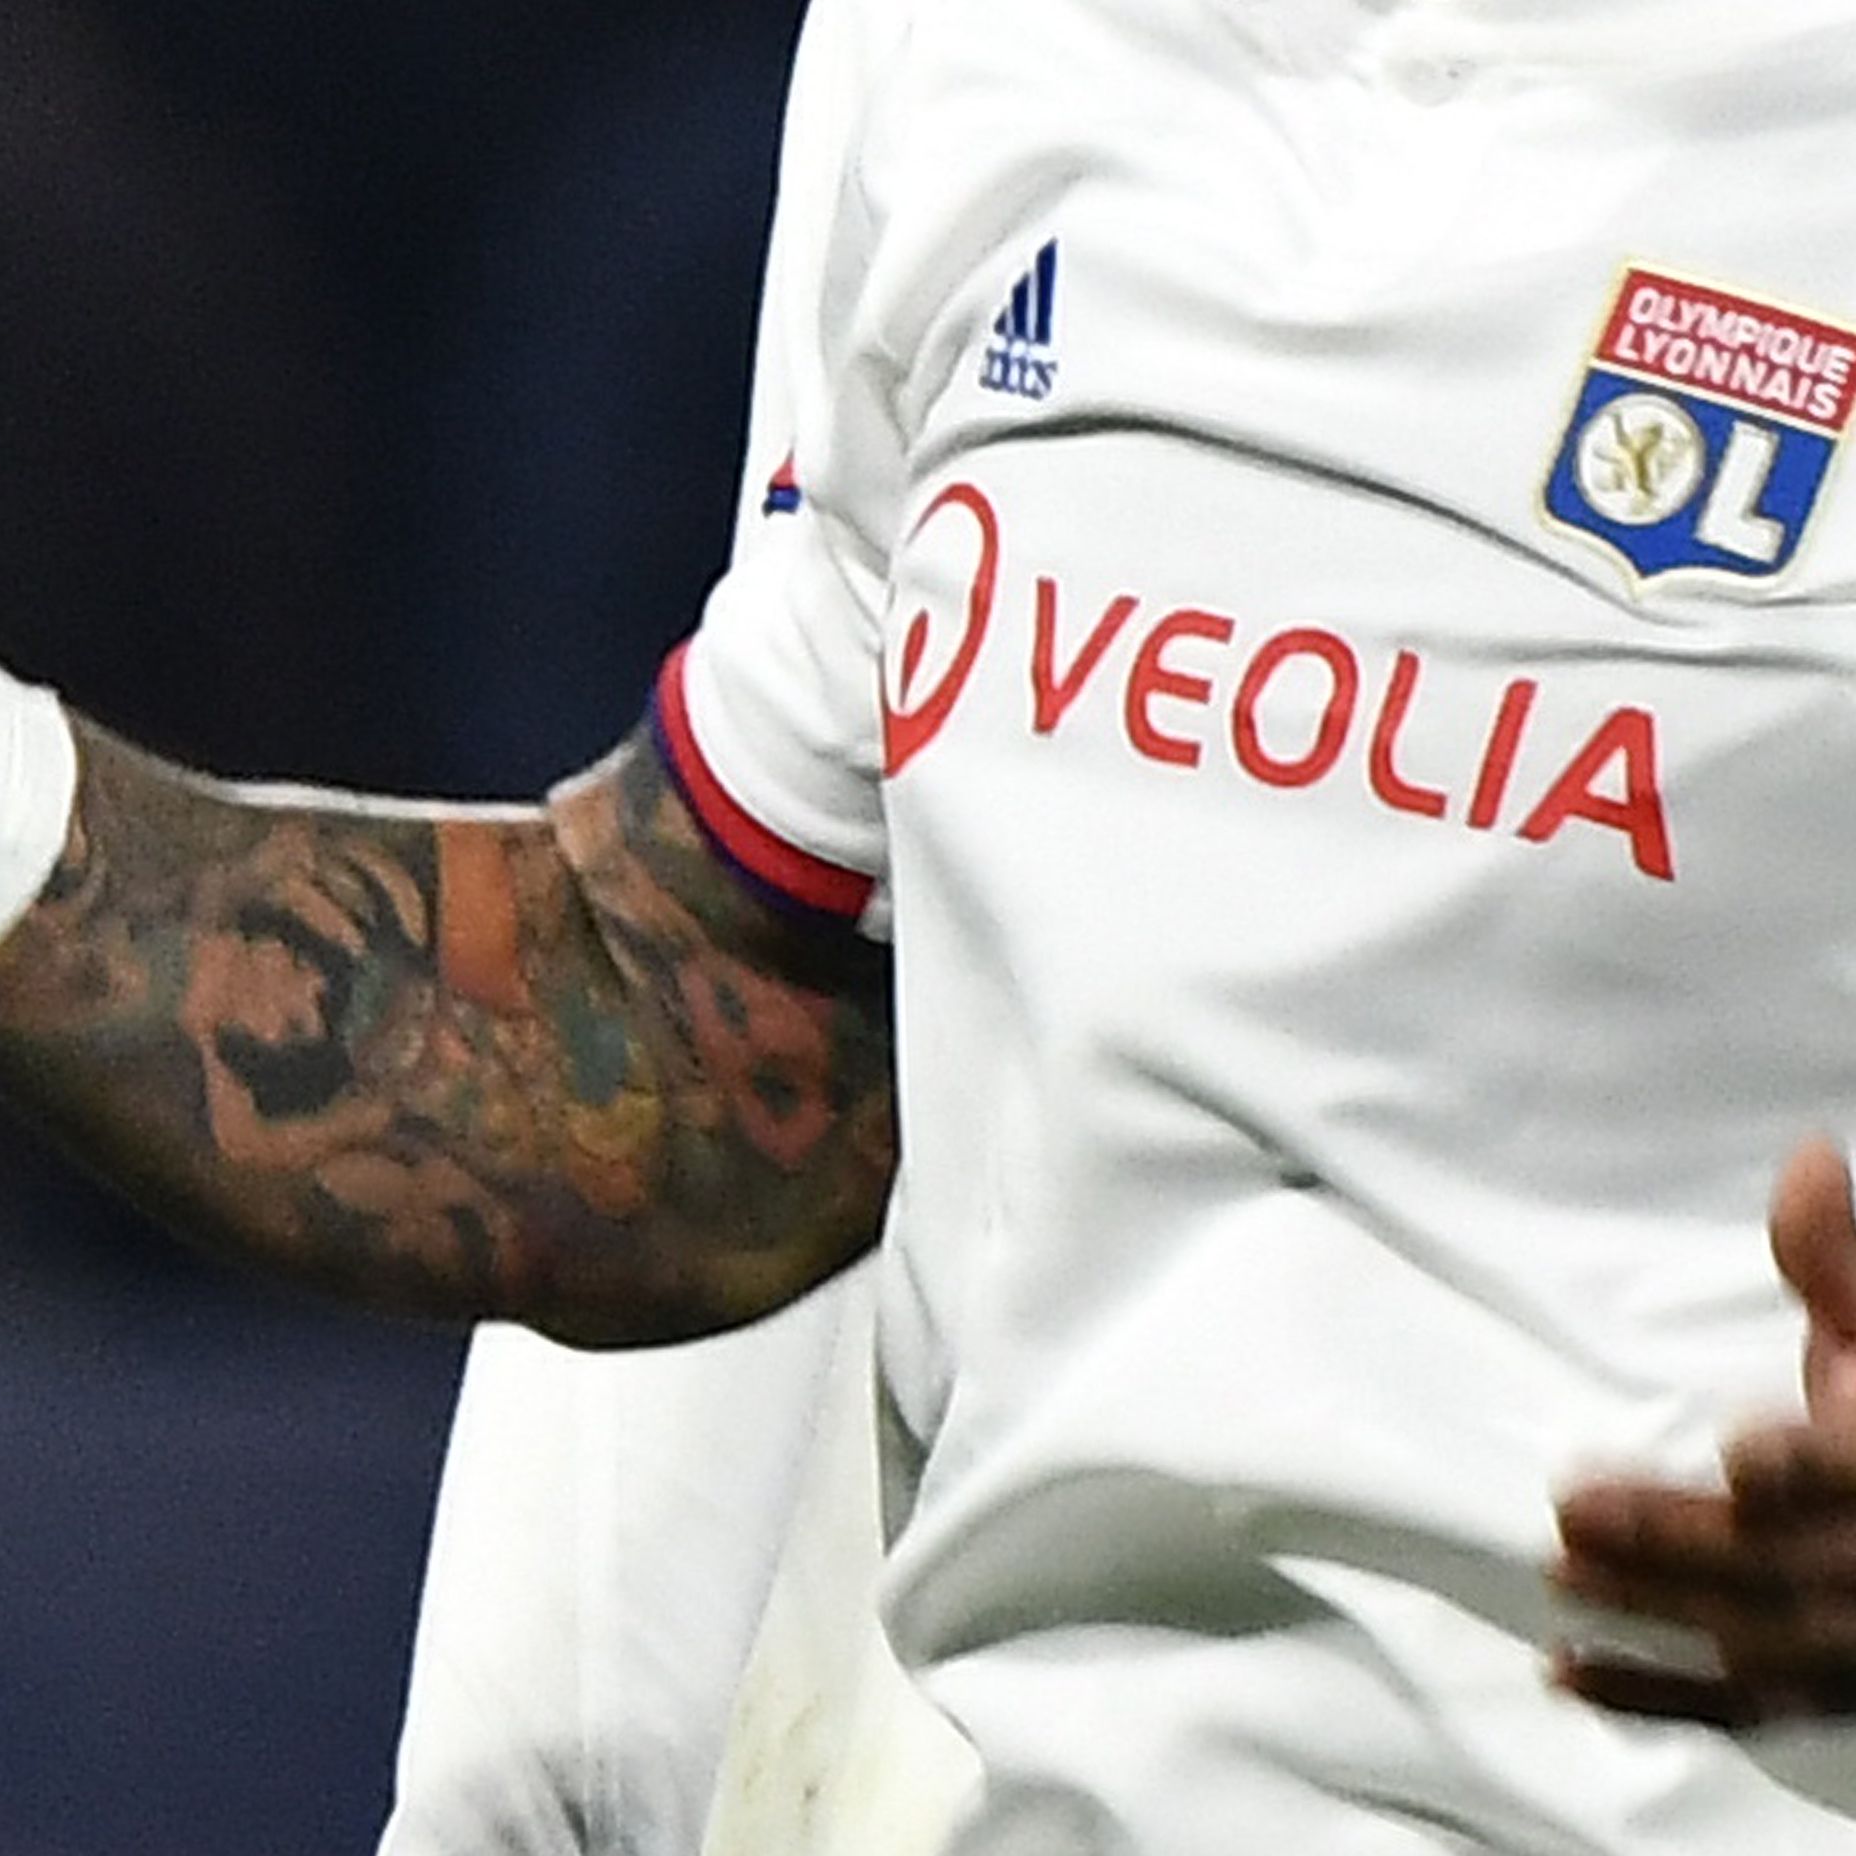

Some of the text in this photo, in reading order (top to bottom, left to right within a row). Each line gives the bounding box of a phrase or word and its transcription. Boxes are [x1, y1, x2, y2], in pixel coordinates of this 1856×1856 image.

[1615, 325, 1843, 419] LYONNAIS
[1629, 287, 1856, 383] OLYMPIQUE
[1030, 577, 1675, 882] VEOLIA
